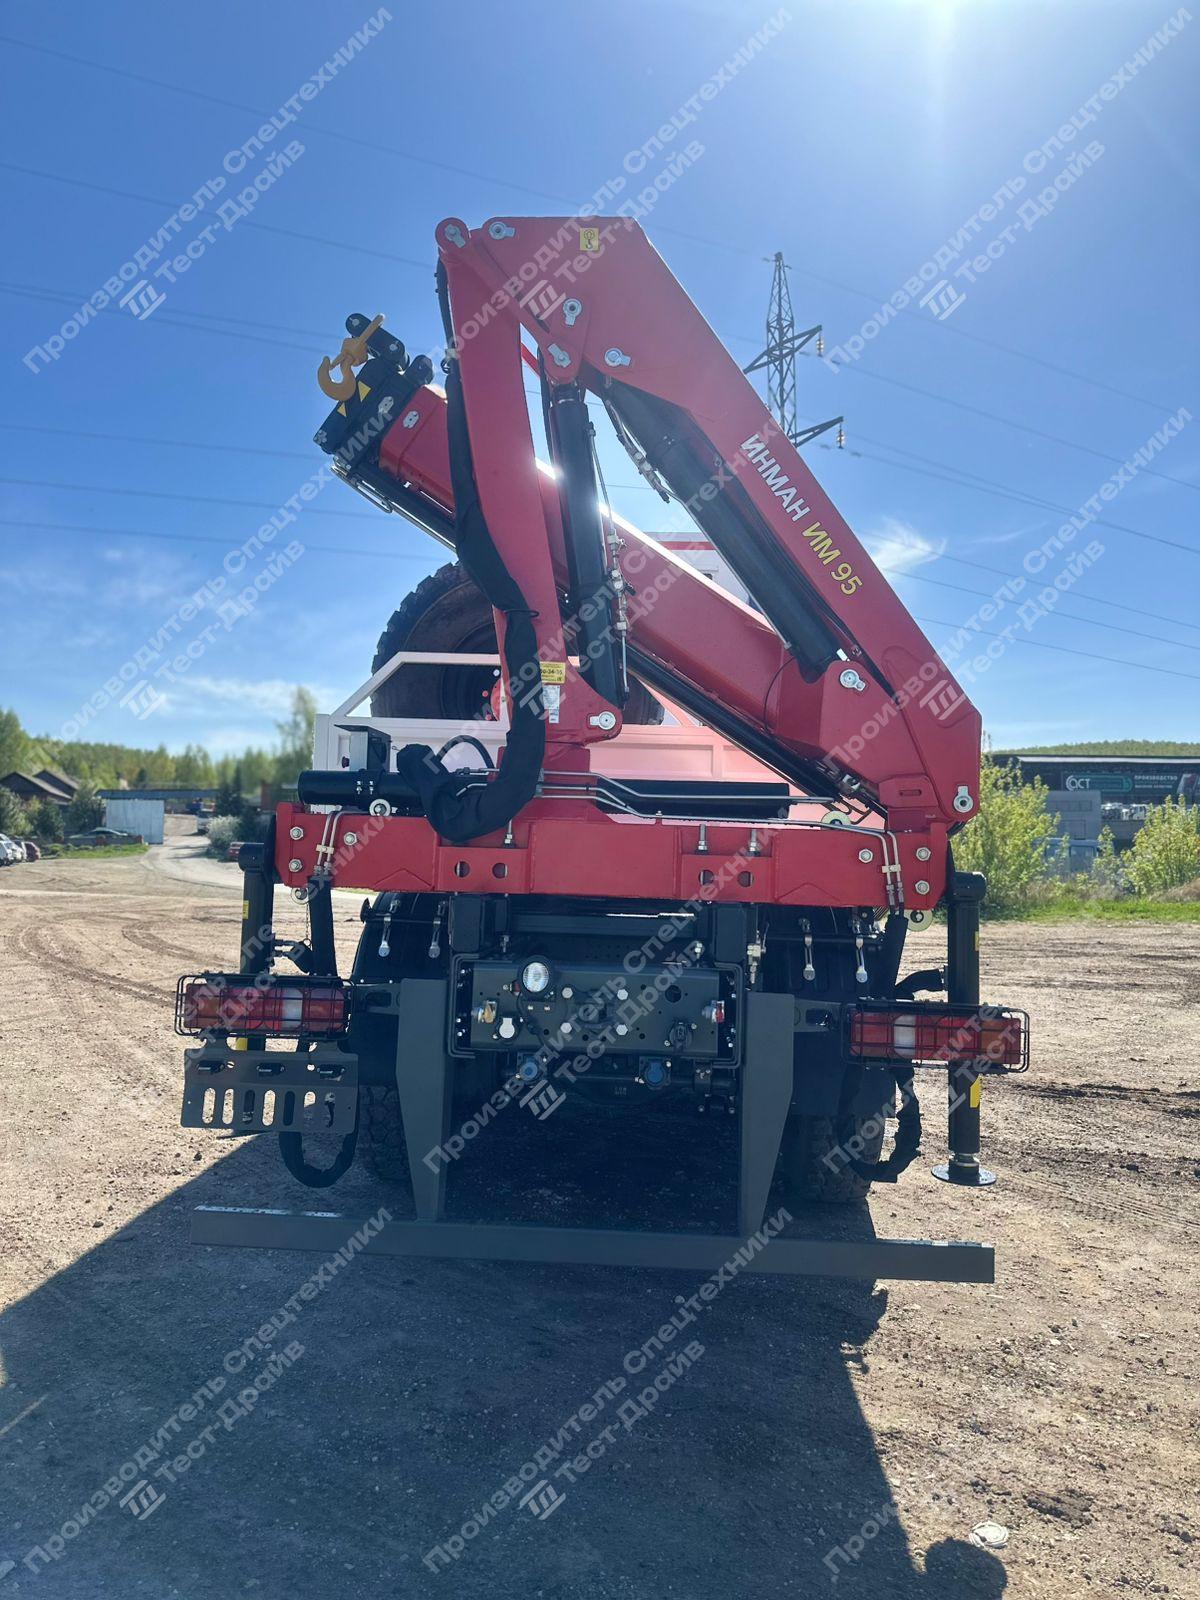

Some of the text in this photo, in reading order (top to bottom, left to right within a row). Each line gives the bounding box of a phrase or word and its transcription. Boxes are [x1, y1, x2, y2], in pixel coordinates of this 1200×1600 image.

[740, 433, 863, 595] ИНМАН ИМ 95
